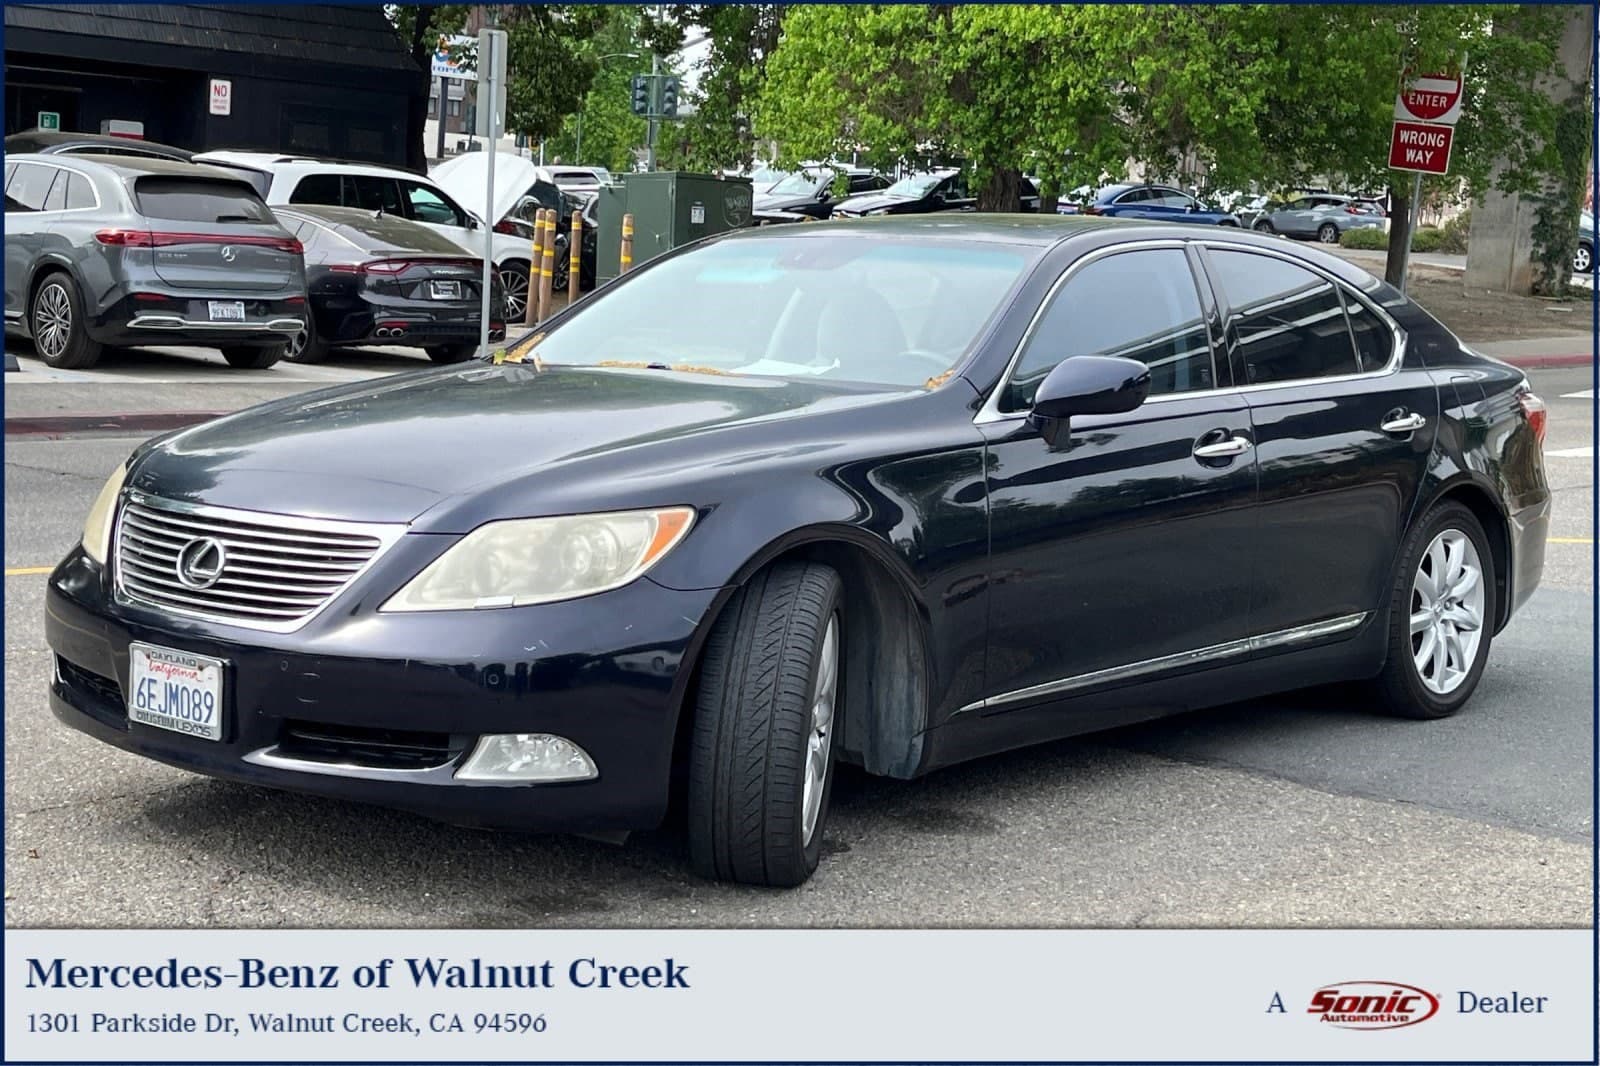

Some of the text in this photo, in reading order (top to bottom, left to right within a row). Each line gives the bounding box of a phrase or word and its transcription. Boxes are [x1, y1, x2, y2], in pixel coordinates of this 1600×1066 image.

[213, 84, 227, 97] NO
[1409, 93, 1447, 108] ENTER
[1400, 130, 1445, 148] WRONG
[1406, 148, 1434, 165] WAY
[149, 660, 203, 681] California
[136, 677, 214, 723] 6EJM089
